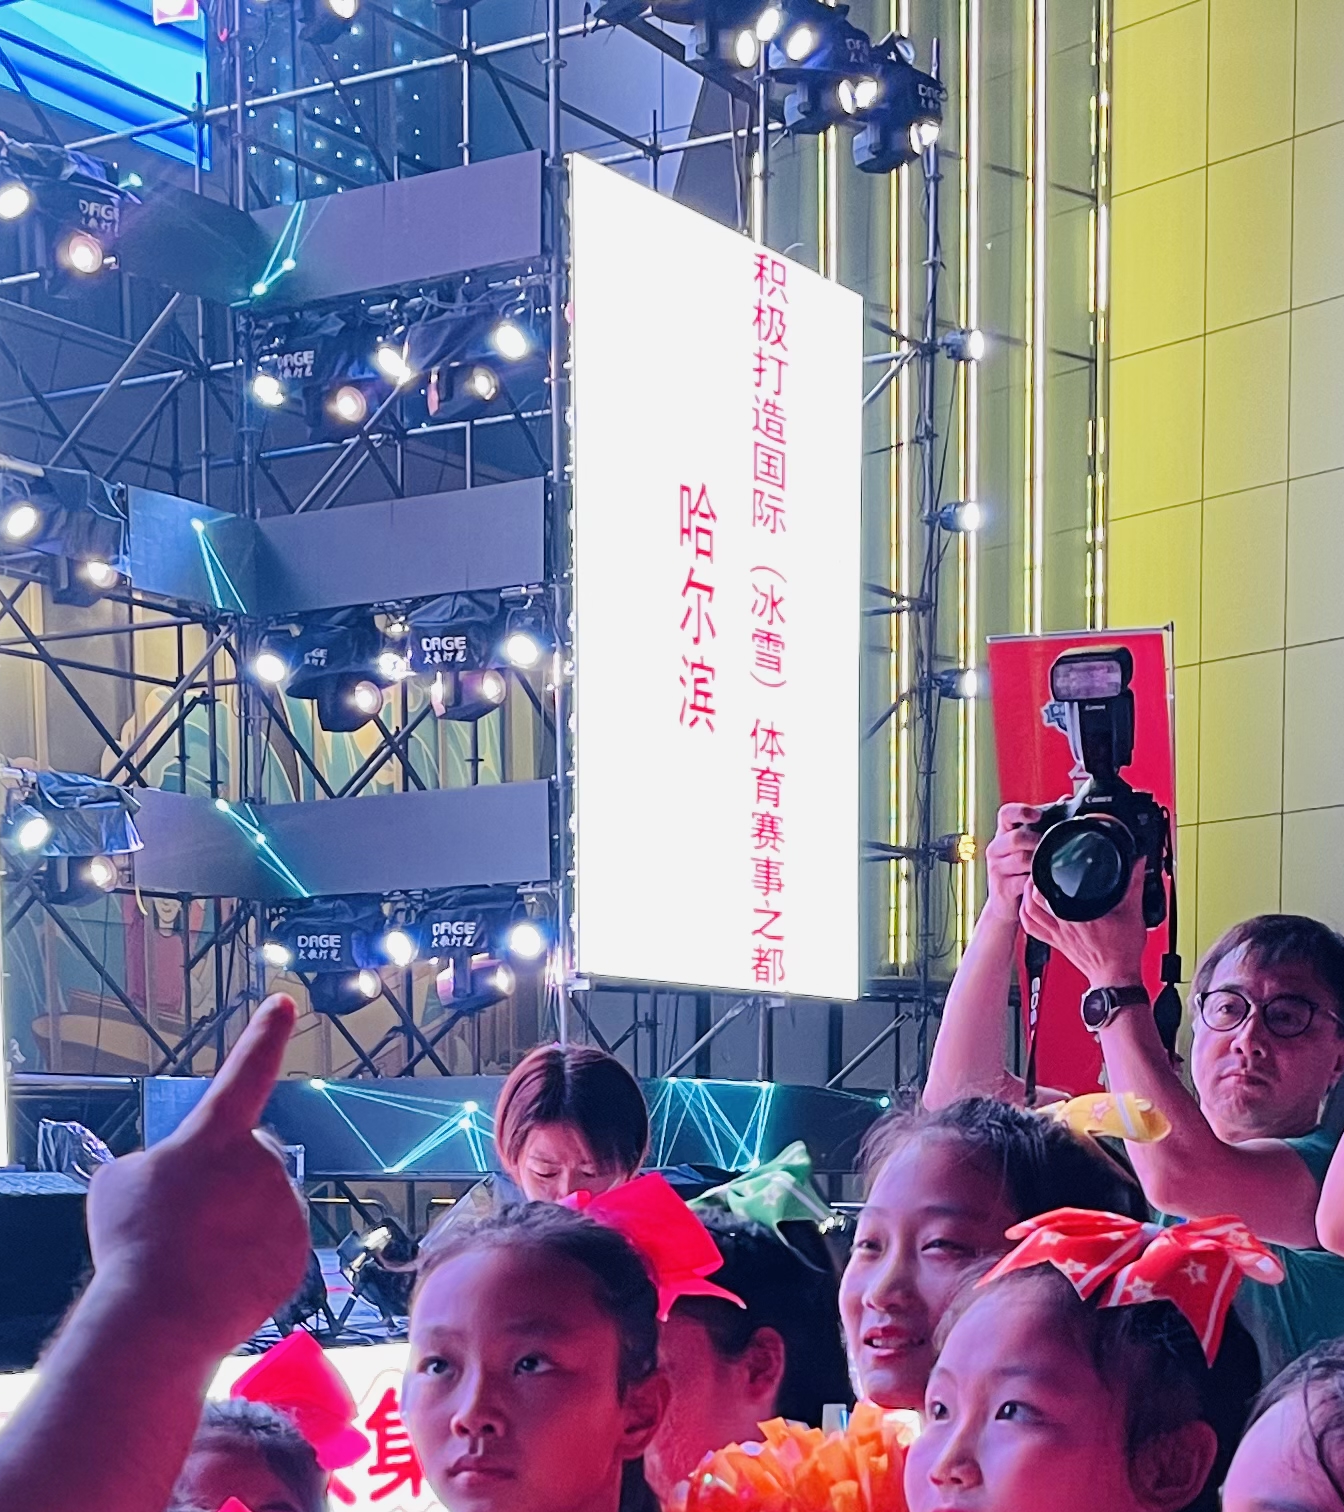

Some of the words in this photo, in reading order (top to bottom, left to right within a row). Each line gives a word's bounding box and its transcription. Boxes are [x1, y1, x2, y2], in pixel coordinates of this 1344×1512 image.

[678, 481, 718, 734] 哈尔滨
[421, 636, 467, 651] DAGE
[431, 921, 477, 937] DAGE
[297, 934, 342, 948] DAGE
